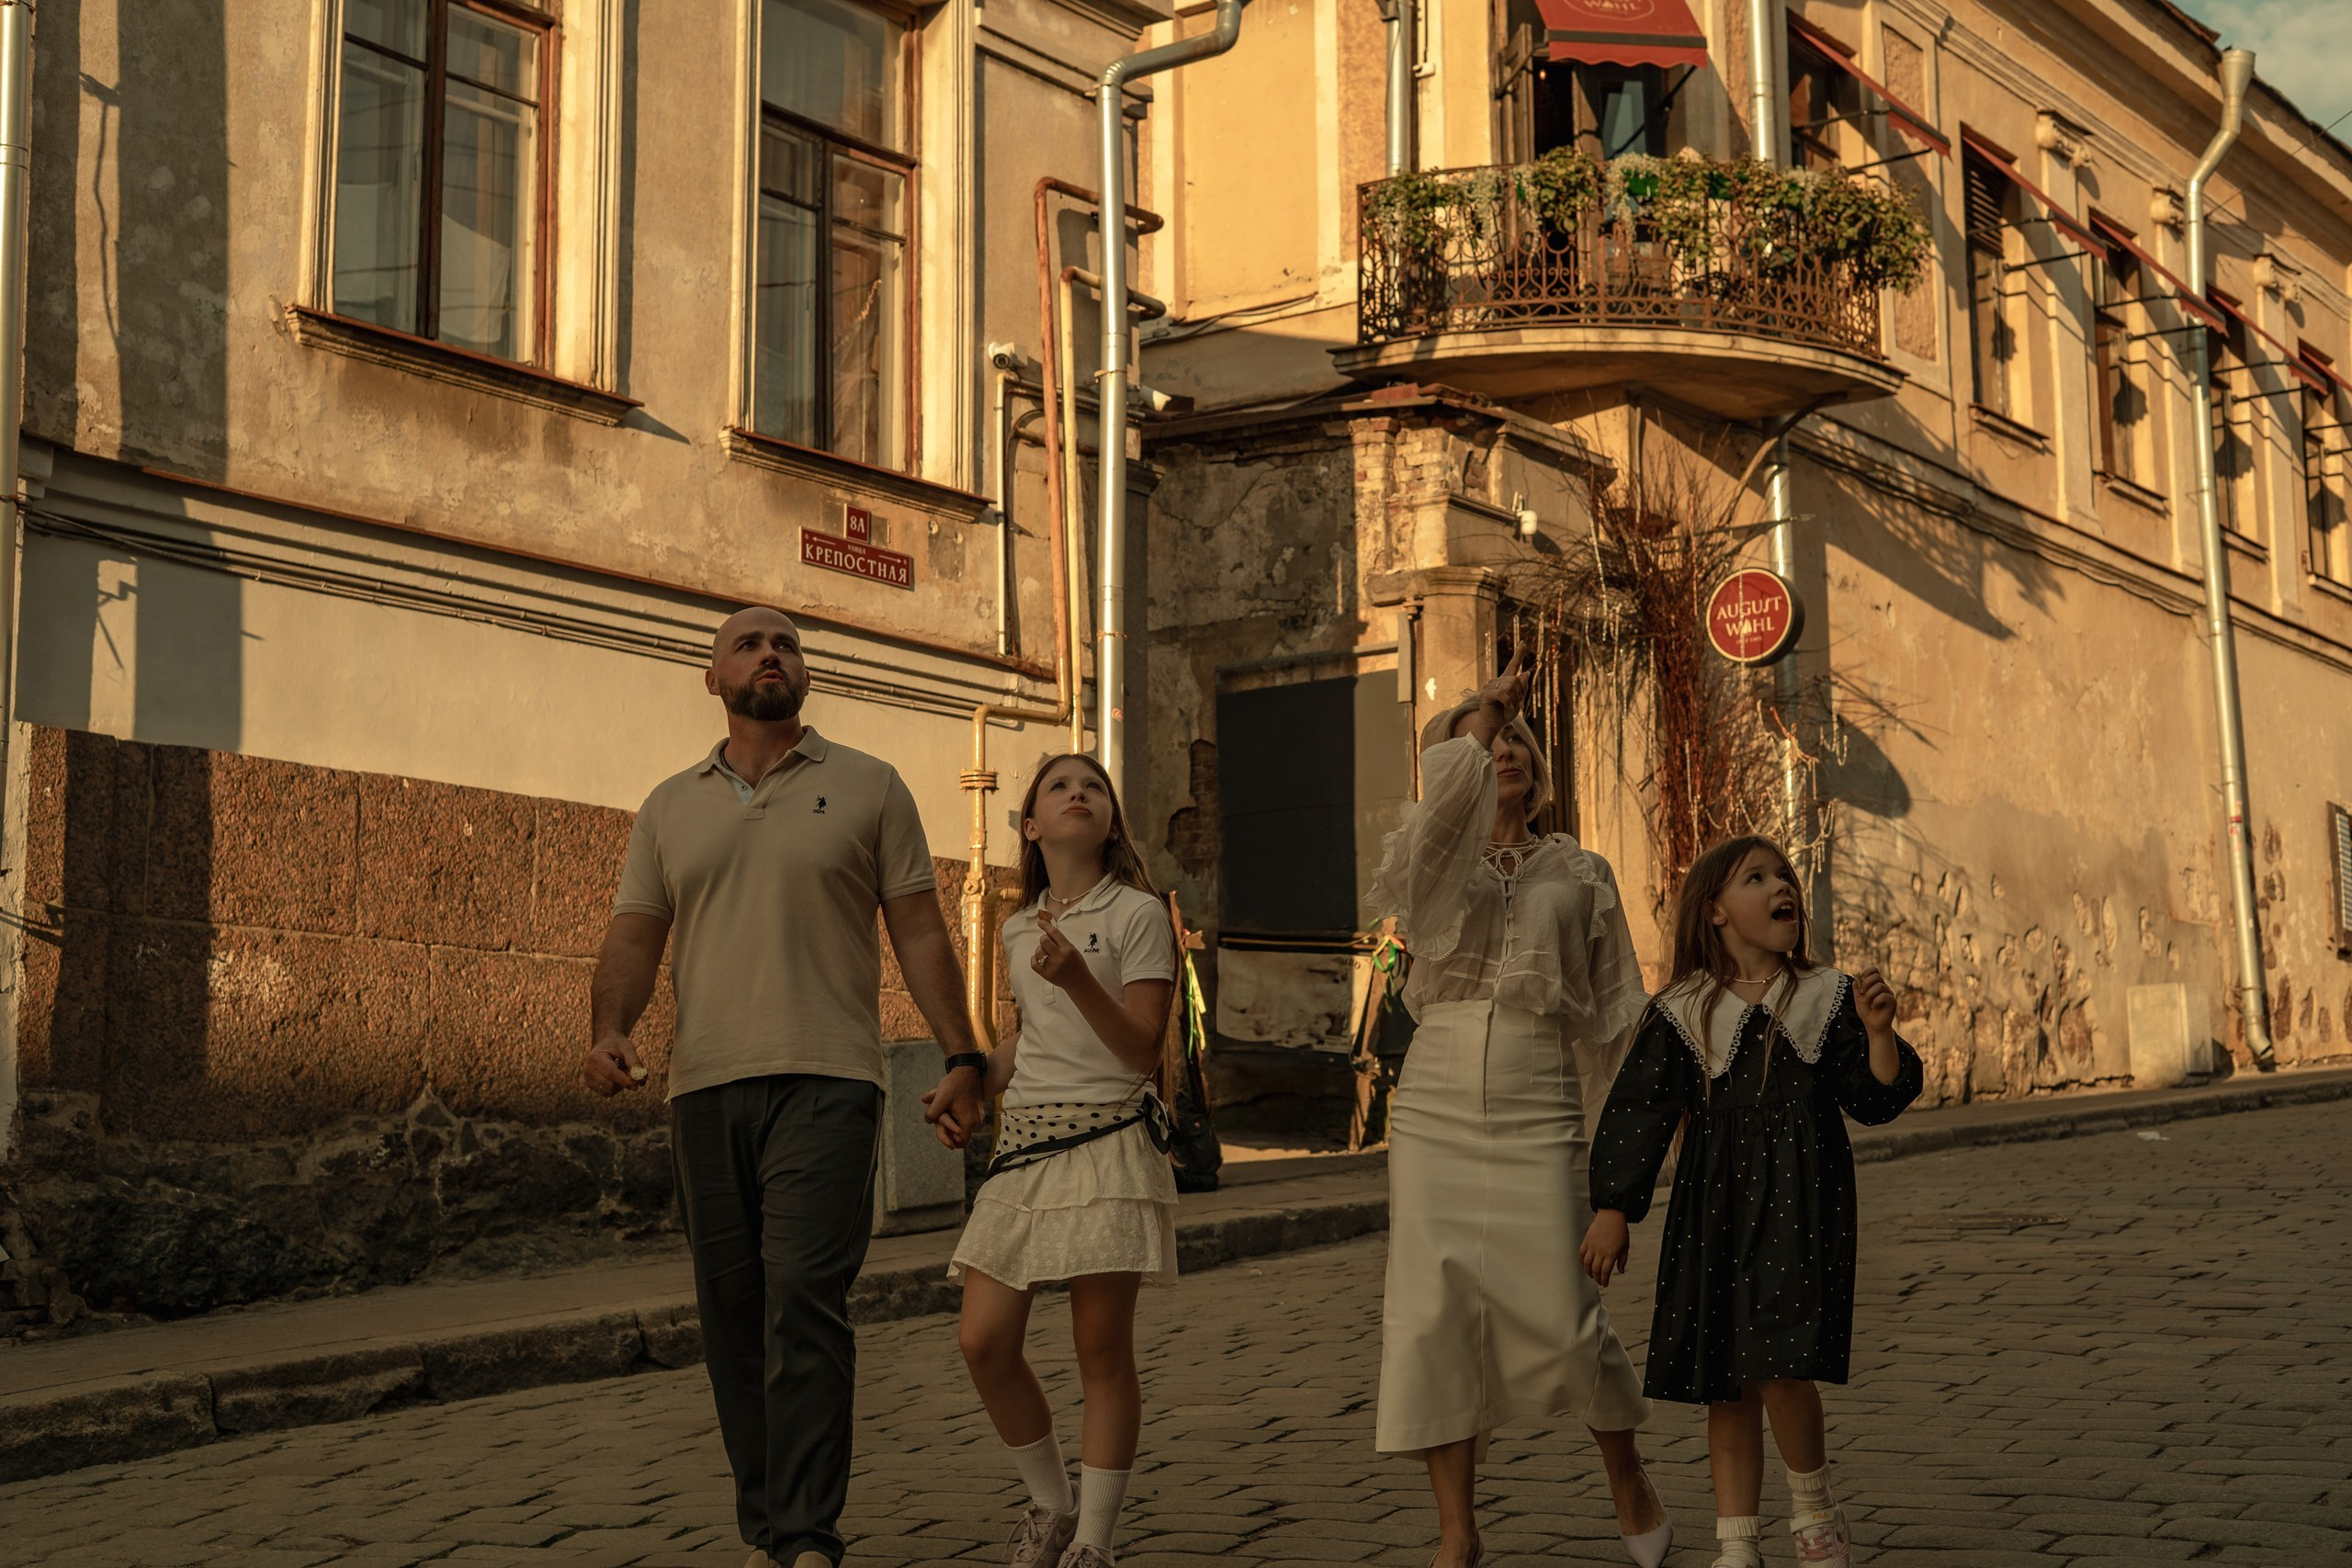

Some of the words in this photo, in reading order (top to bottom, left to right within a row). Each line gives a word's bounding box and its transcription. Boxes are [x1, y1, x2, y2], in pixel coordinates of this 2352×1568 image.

[850, 515, 865, 533] 8А
[806, 543, 907, 583] КРЕПОСТНАЯ
[1716, 595, 1781, 620] AUGUST
[1725, 616, 1775, 637] WAHL
[1812, 1512, 1828, 1520] FILA
